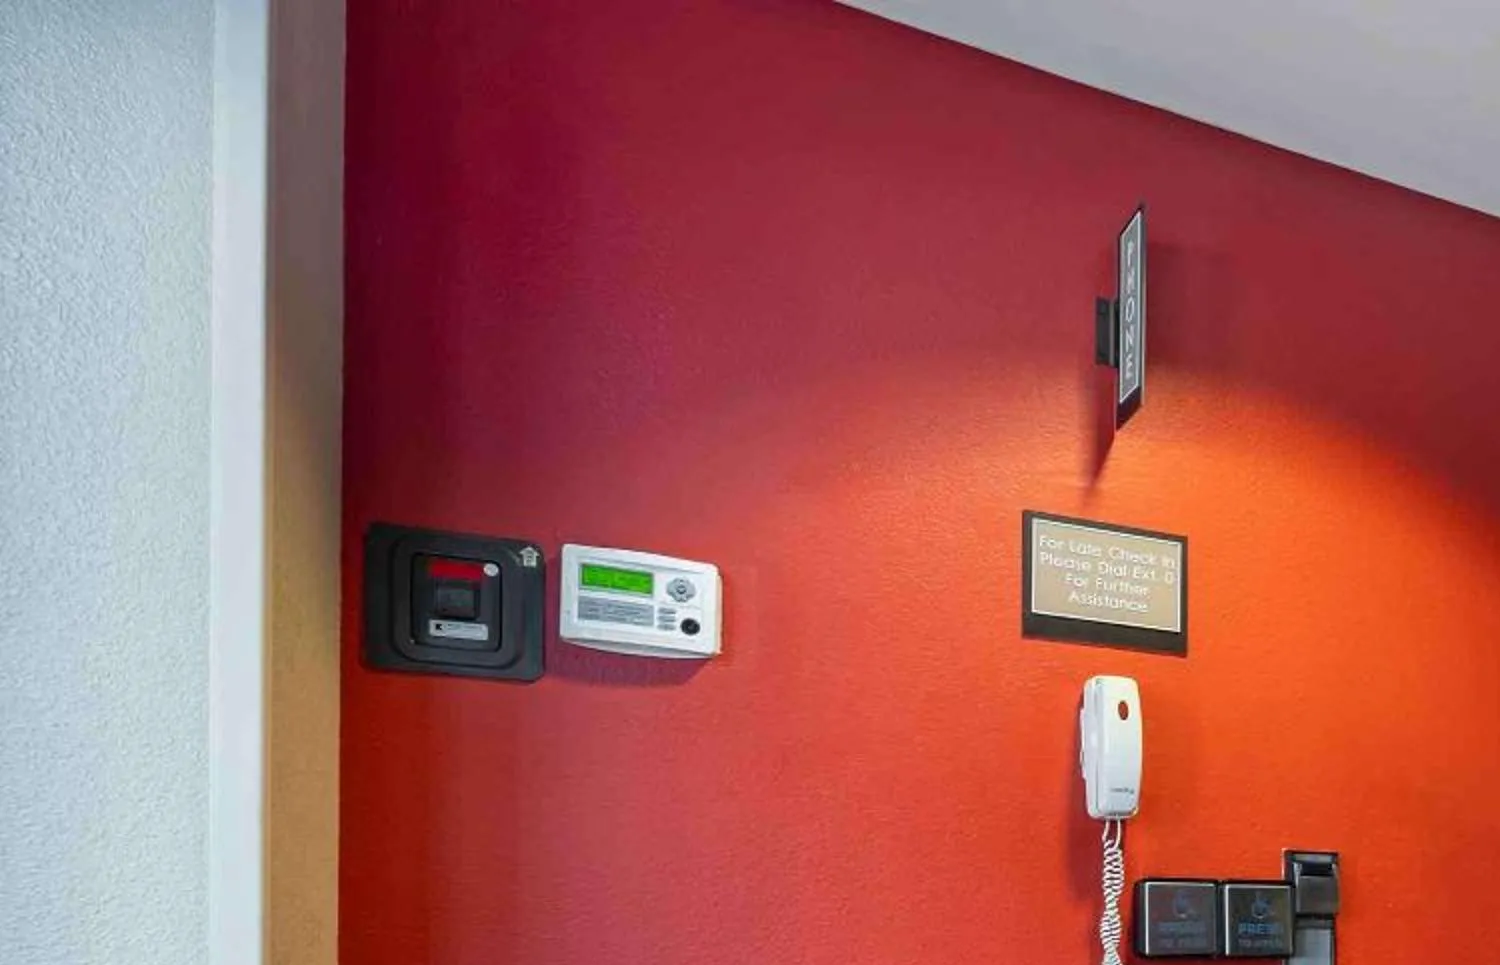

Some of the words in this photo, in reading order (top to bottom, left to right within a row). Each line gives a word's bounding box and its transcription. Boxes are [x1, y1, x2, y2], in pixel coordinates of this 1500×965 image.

[1125, 240, 1136, 379] PHONE
[1039, 535, 1065, 549] For
[1069, 539, 1101, 557] Late
[1108, 546, 1158, 565] Check
[1040, 552, 1091, 572] Please
[1098, 562, 1127, 577] Dial
[1065, 574, 1088, 587] For
[1095, 578, 1149, 595] Further
[1069, 591, 1149, 613] Assistance
